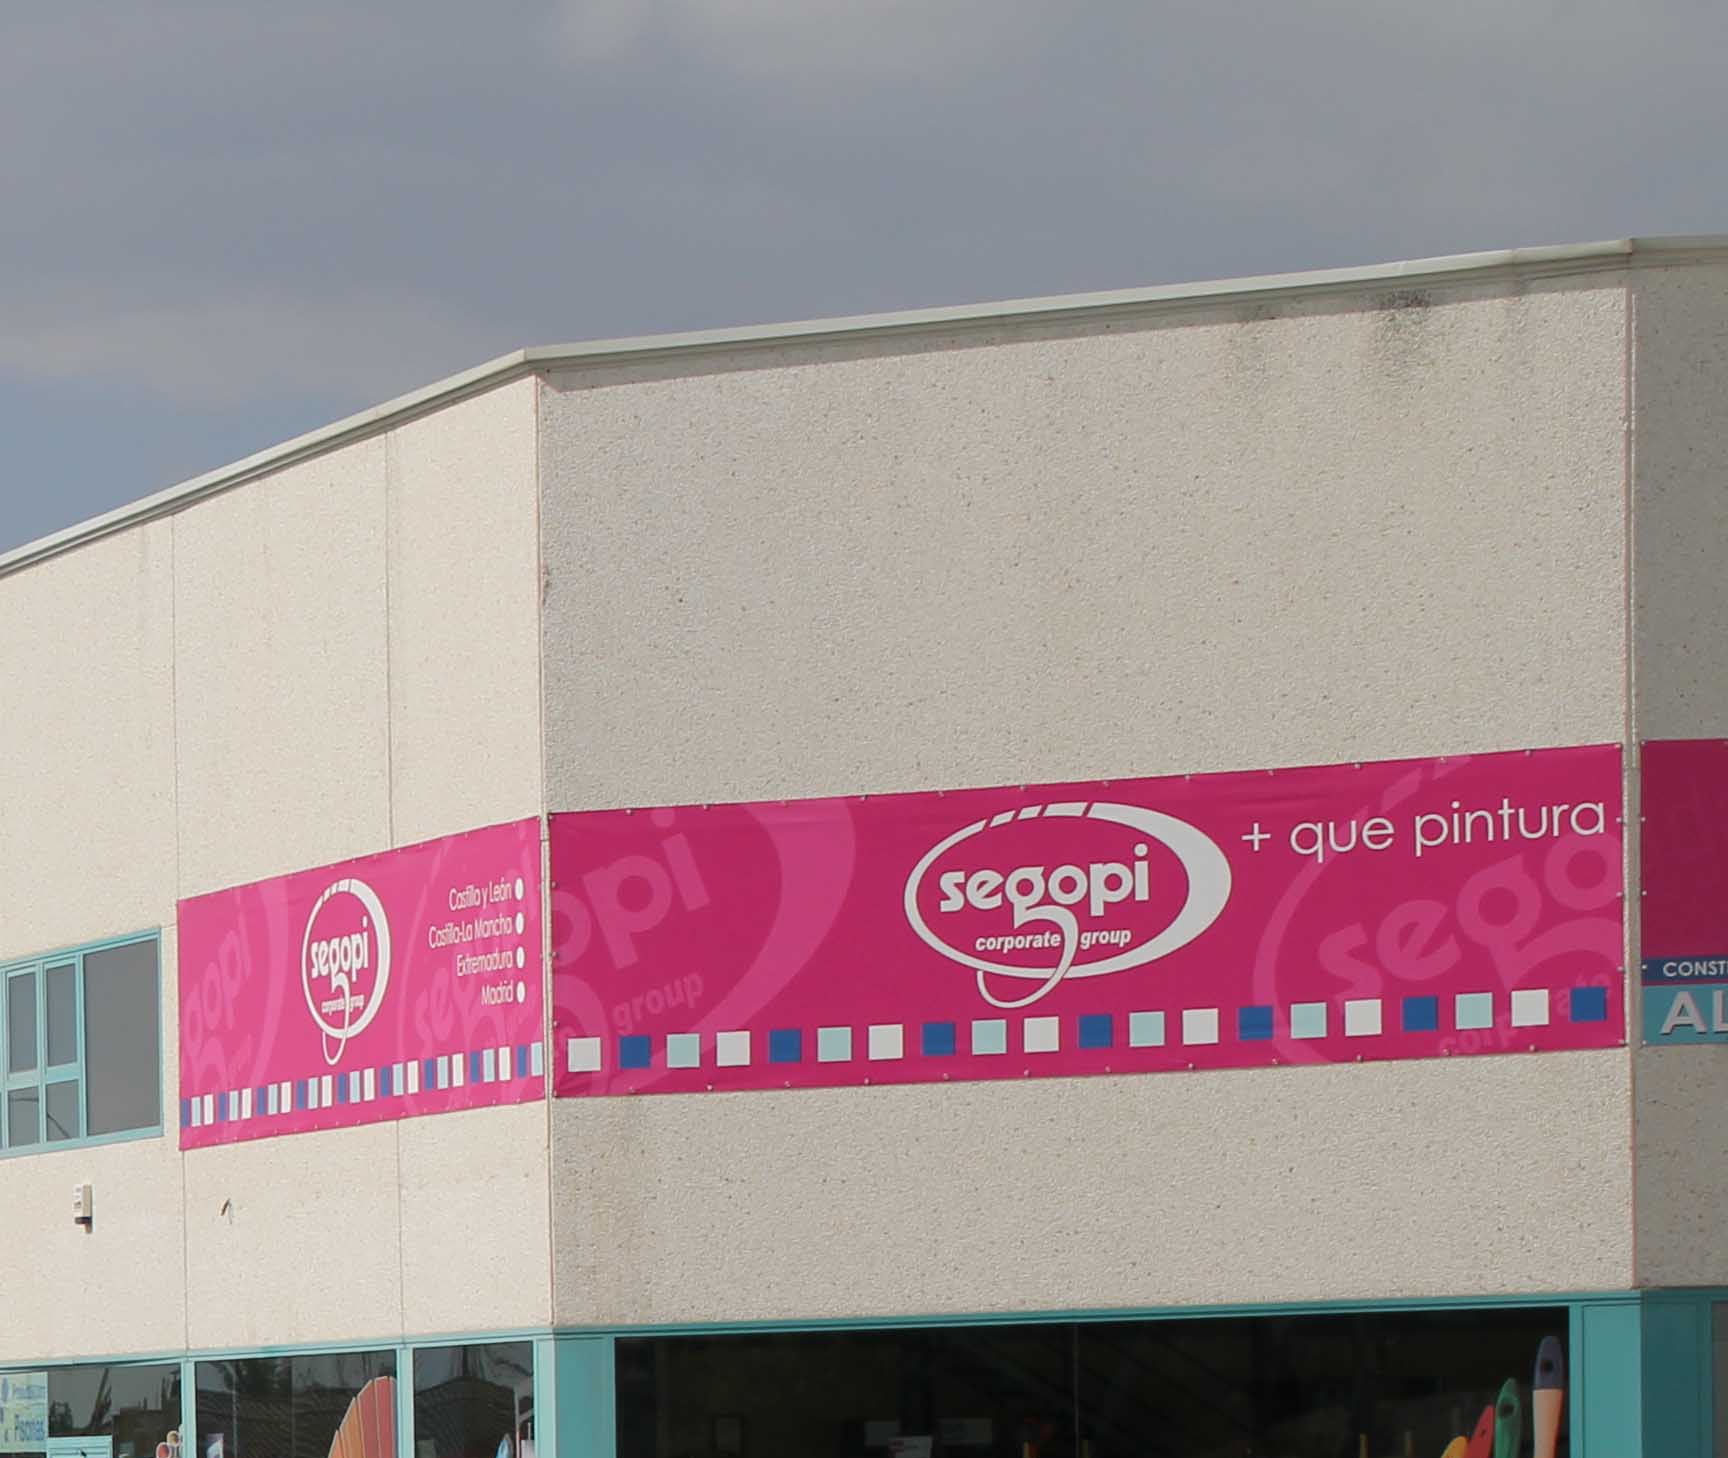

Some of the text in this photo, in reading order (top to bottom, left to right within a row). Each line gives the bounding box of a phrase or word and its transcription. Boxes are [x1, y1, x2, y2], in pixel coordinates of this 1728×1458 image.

[1290, 817, 1394, 863] que
[1415, 798, 1605, 857] pintura
[449, 877, 512, 911] Castilla y León
[939, 843, 1150, 930] segopi
[428, 913, 512, 949] Castilla-La Mancha
[975, 929, 1132, 954] corporate group
[310, 915, 368, 992] segopi
[457, 948, 513, 977] Extremadura
[1662, 961, 1728, 977] CONST
[481, 979, 514, 1006] Madrid
[612, 972, 704, 1036] group
